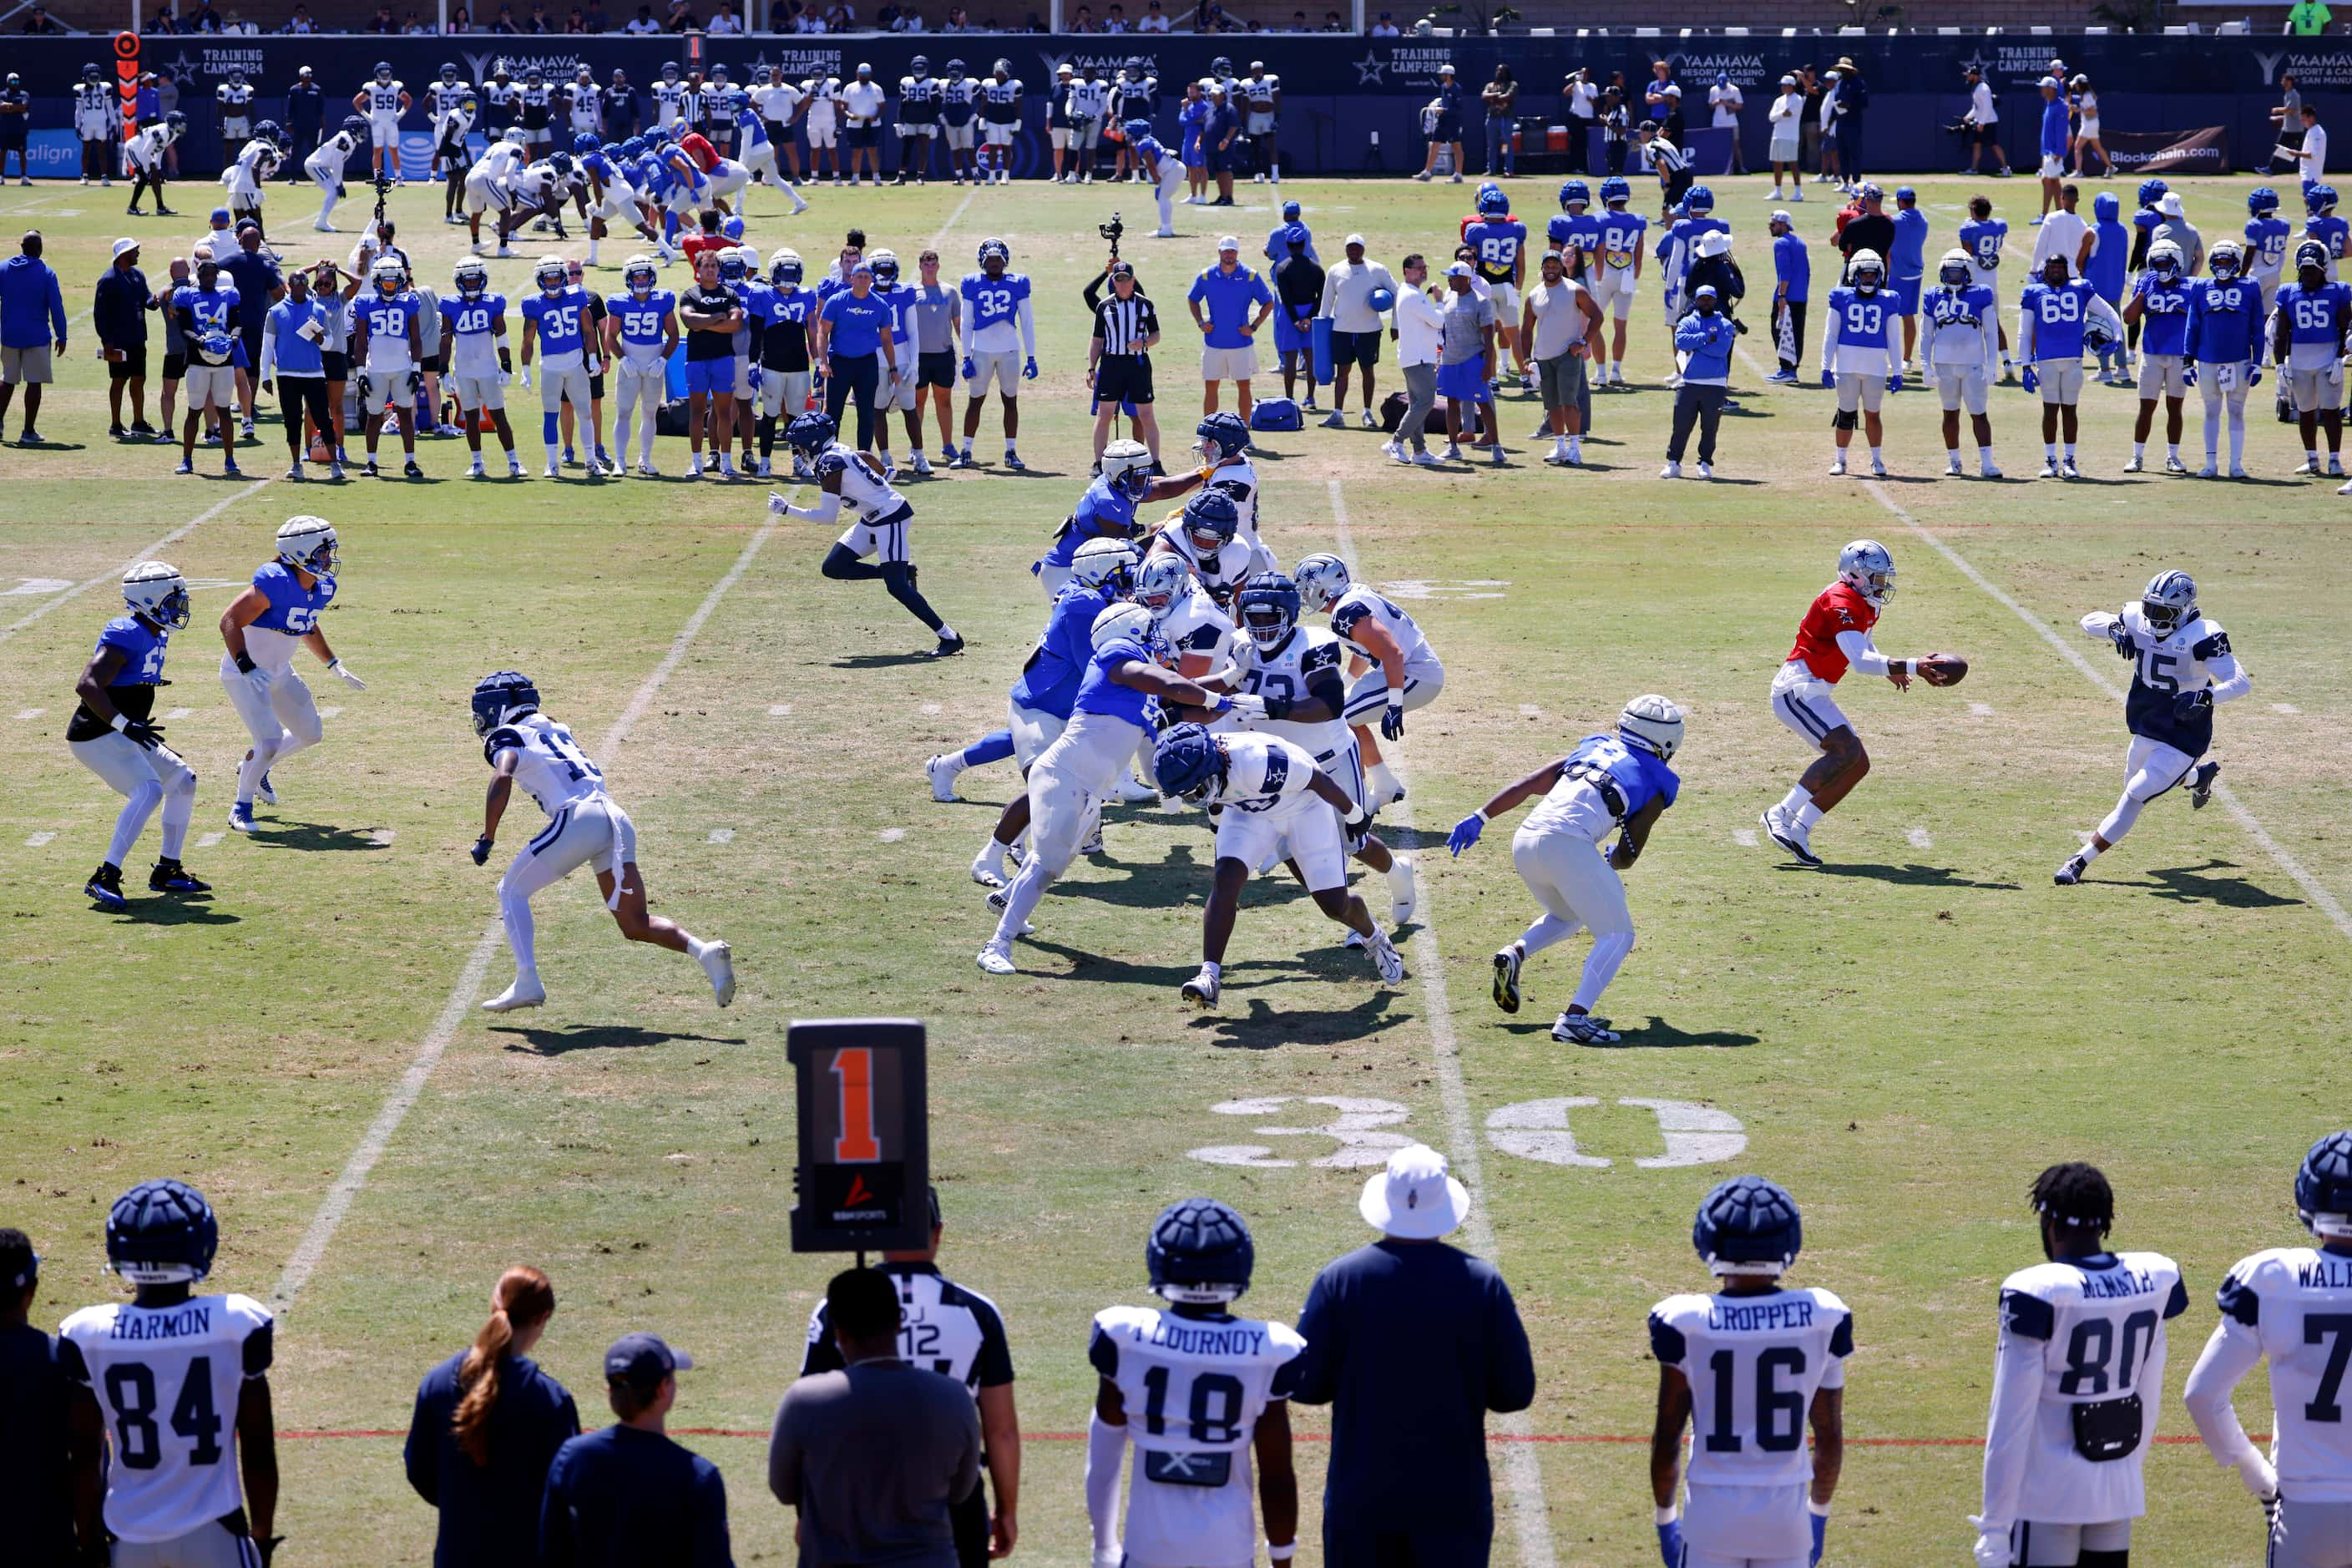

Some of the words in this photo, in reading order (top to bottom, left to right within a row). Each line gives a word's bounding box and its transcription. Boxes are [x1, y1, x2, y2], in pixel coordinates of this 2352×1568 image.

[203, 49, 263, 61] TRAINING
[691, 37, 699, 58] 1
[781, 49, 841, 61] TRAINING
[1392, 48, 1450, 59] TRAINING
[1683, 53, 1764, 68] YAAMAVA'
[1998, 47, 2057, 58] TRAINING
[1681, 68, 1717, 77] RESORT
[1729, 68, 1766, 77] CASINO
[83, 93, 104, 110] 33
[376, 94, 395, 110] 59
[576, 96, 595, 113] 45
[710, 96, 729, 110] 52
[1079, 89, 1096, 102] 91
[2110, 147, 2219, 164] Blockchain.com
[1482, 237, 1518, 263] 83
[1605, 227, 1639, 252] 84
[193, 301, 228, 331] 54
[772, 301, 806, 323] 97
[978, 290, 1011, 317] 32
[2041, 291, 2079, 324] 69
[2295, 299, 2329, 329] 65
[369, 308, 404, 336] 58
[456, 309, 488, 332] 48
[544, 306, 579, 338] 35
[1848, 303, 1882, 334] 93
[2136, 648, 2179, 695] 15
[829, 1047, 882, 1164] 1
[110, 1307, 210, 1340] HARMON
[1708, 1301, 1813, 1331] CROPPER
[896, 1324, 941, 1356] 12
[2058, 1308, 2160, 1396] 80
[2304, 1313, 2352, 1424] 7
[104, 1355, 222, 1470] 84
[1143, 1364, 1245, 1444] 18
[1705, 1346, 1807, 1454] 16
